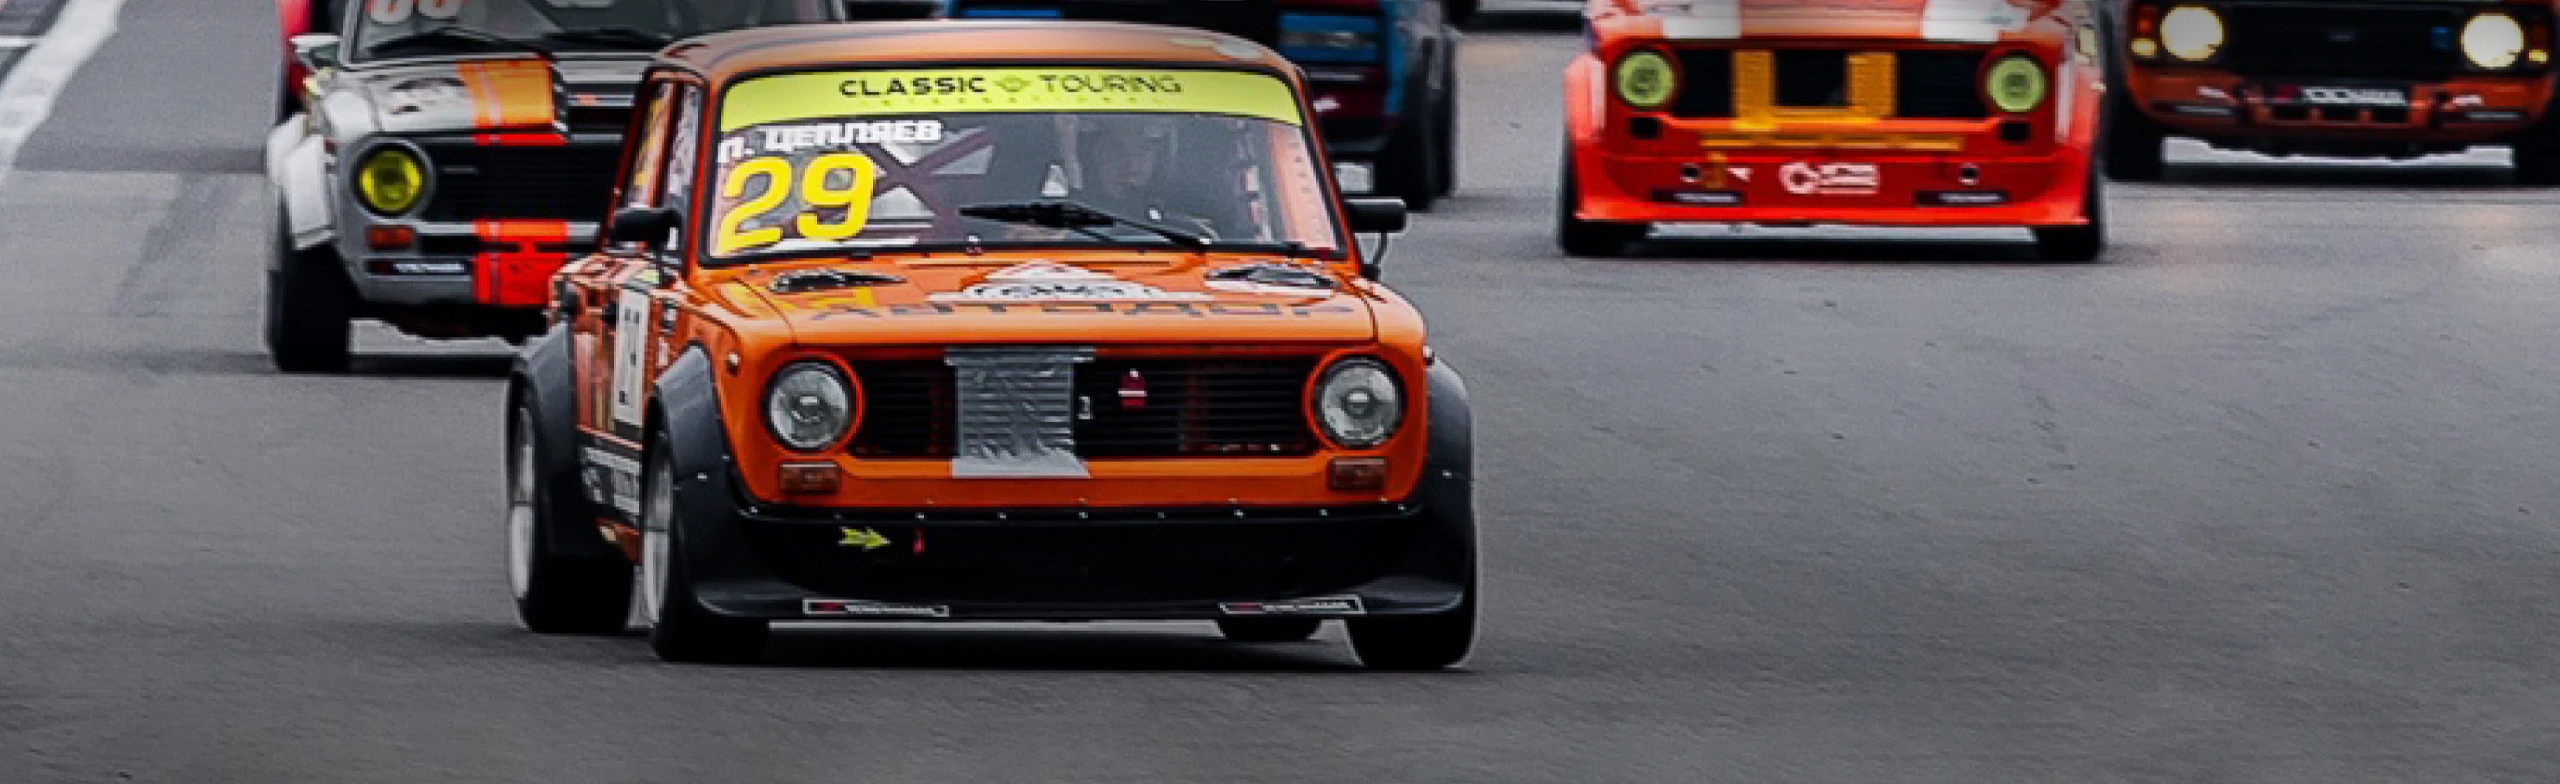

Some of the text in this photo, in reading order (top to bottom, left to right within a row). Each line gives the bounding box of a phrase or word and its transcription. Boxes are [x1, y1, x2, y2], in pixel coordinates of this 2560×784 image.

[839, 74, 1182, 96] CLASSIC TOURING
[718, 154, 875, 255] 29
